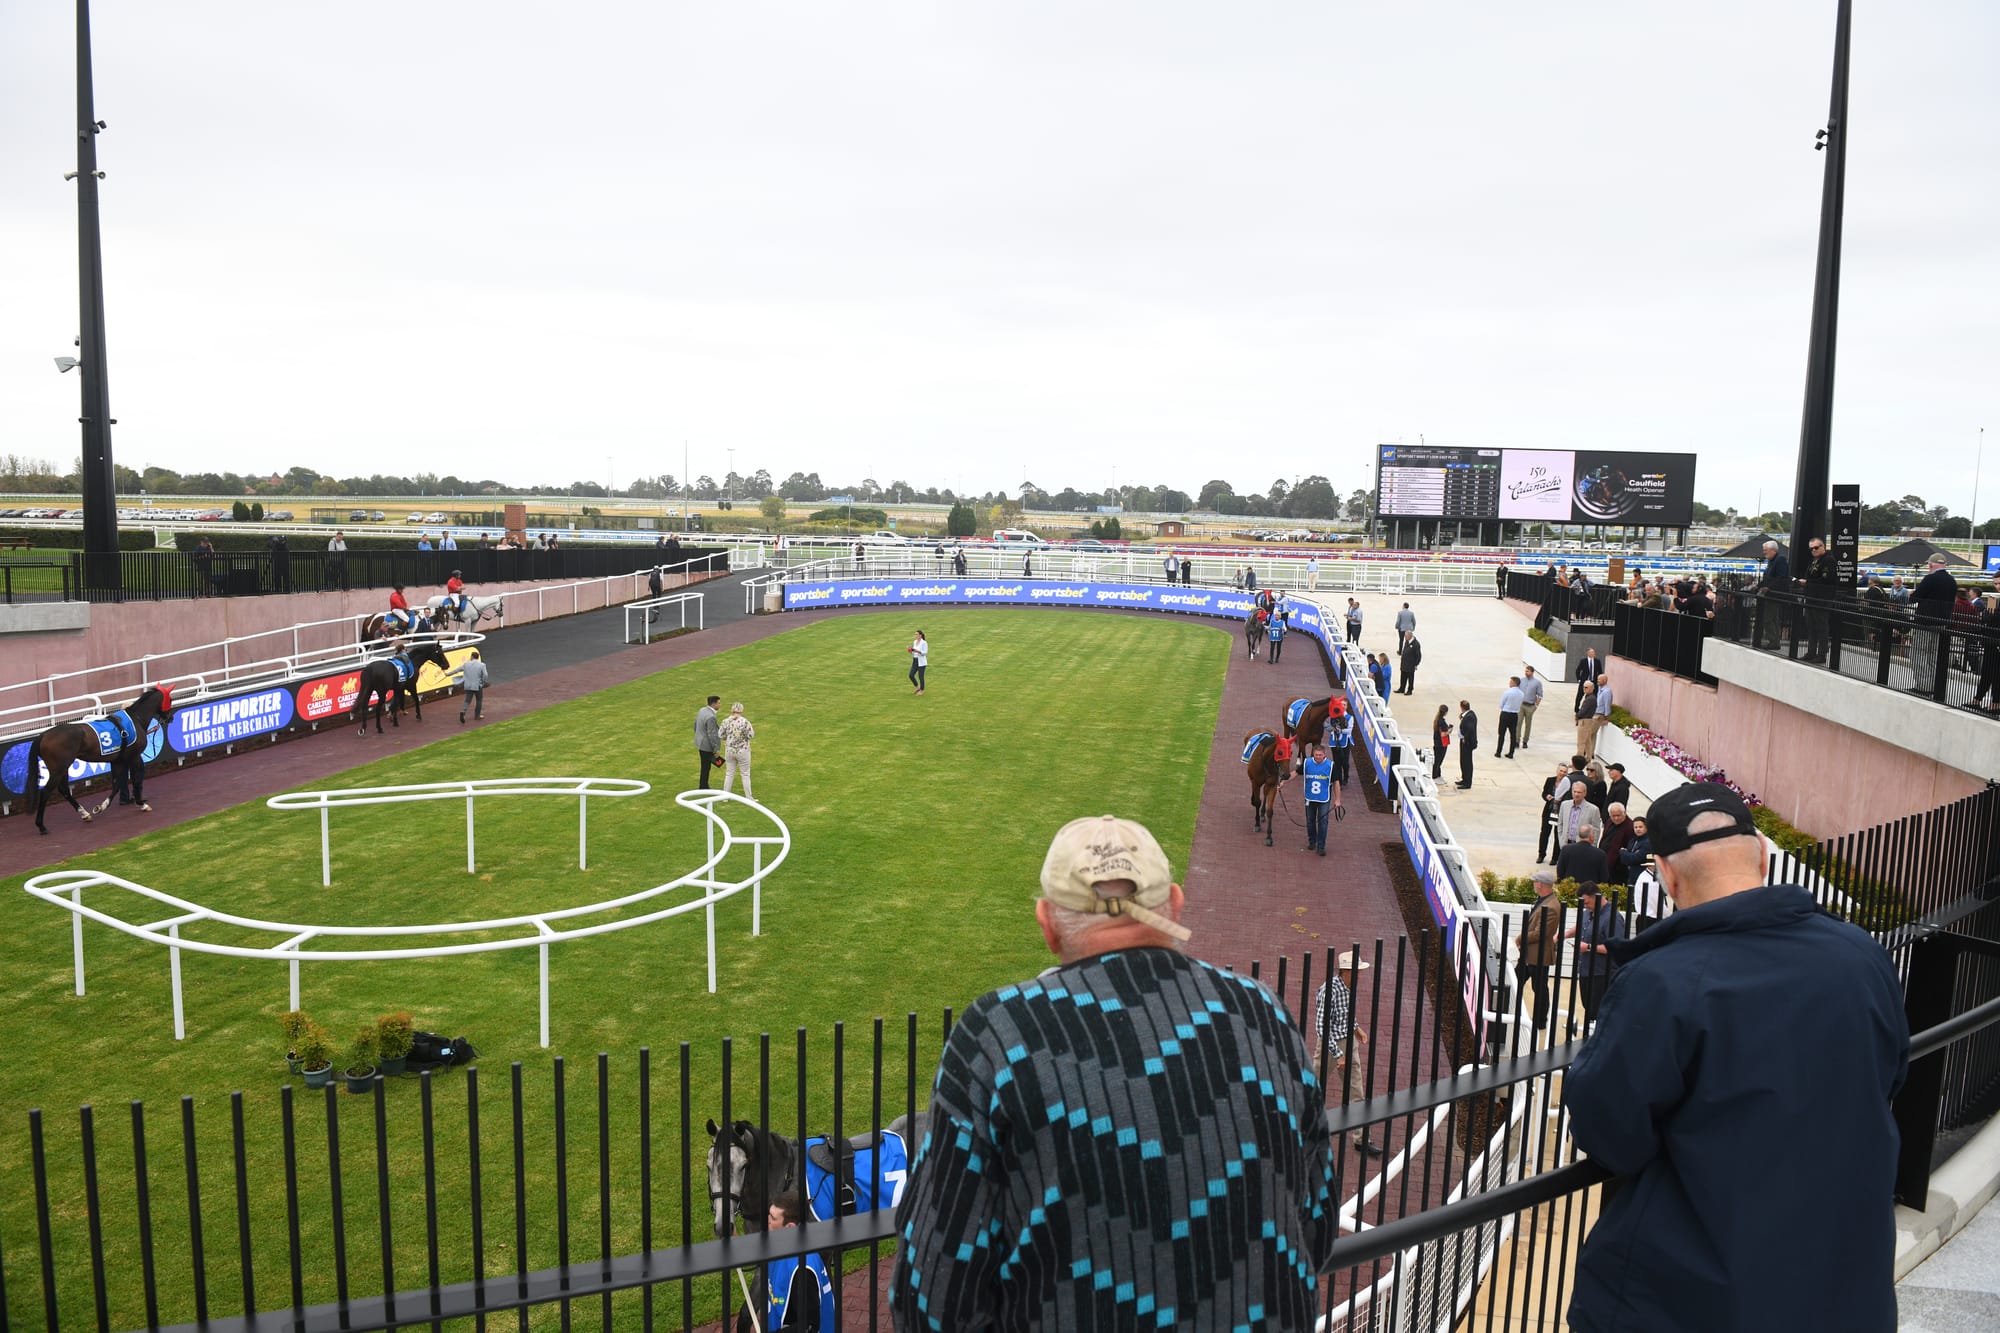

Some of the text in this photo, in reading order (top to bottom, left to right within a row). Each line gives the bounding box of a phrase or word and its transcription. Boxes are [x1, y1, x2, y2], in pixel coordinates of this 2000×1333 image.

[1530, 467, 1546, 479] 150
[1628, 479, 1666, 487] Caulfield
[1834, 500, 1858, 508] Mounting
[789, 588, 832, 604] sportsbet
[841, 585, 889, 600] sportsbet
[900, 584, 952, 599] sportsbet
[964, 585, 1018, 598] sportsbet
[1030, 587, 1084, 600] sportsbet
[1097, 590, 1148, 602] sportsbet
[1160, 593, 1207, 607] sportsbet
[1217, 598, 1256, 611] sportsbe
[307, 698, 332, 710] CARLTON
[181, 691, 282, 733] TILE IMPORTER
[308, 705, 332, 717] DRAUGHT
[183, 712, 281, 749] TIMBER MERCHANT
[100, 731, 112, 747] 3
[1311, 781, 1321, 794] 8
[884, 1169, 907, 1208] 7
